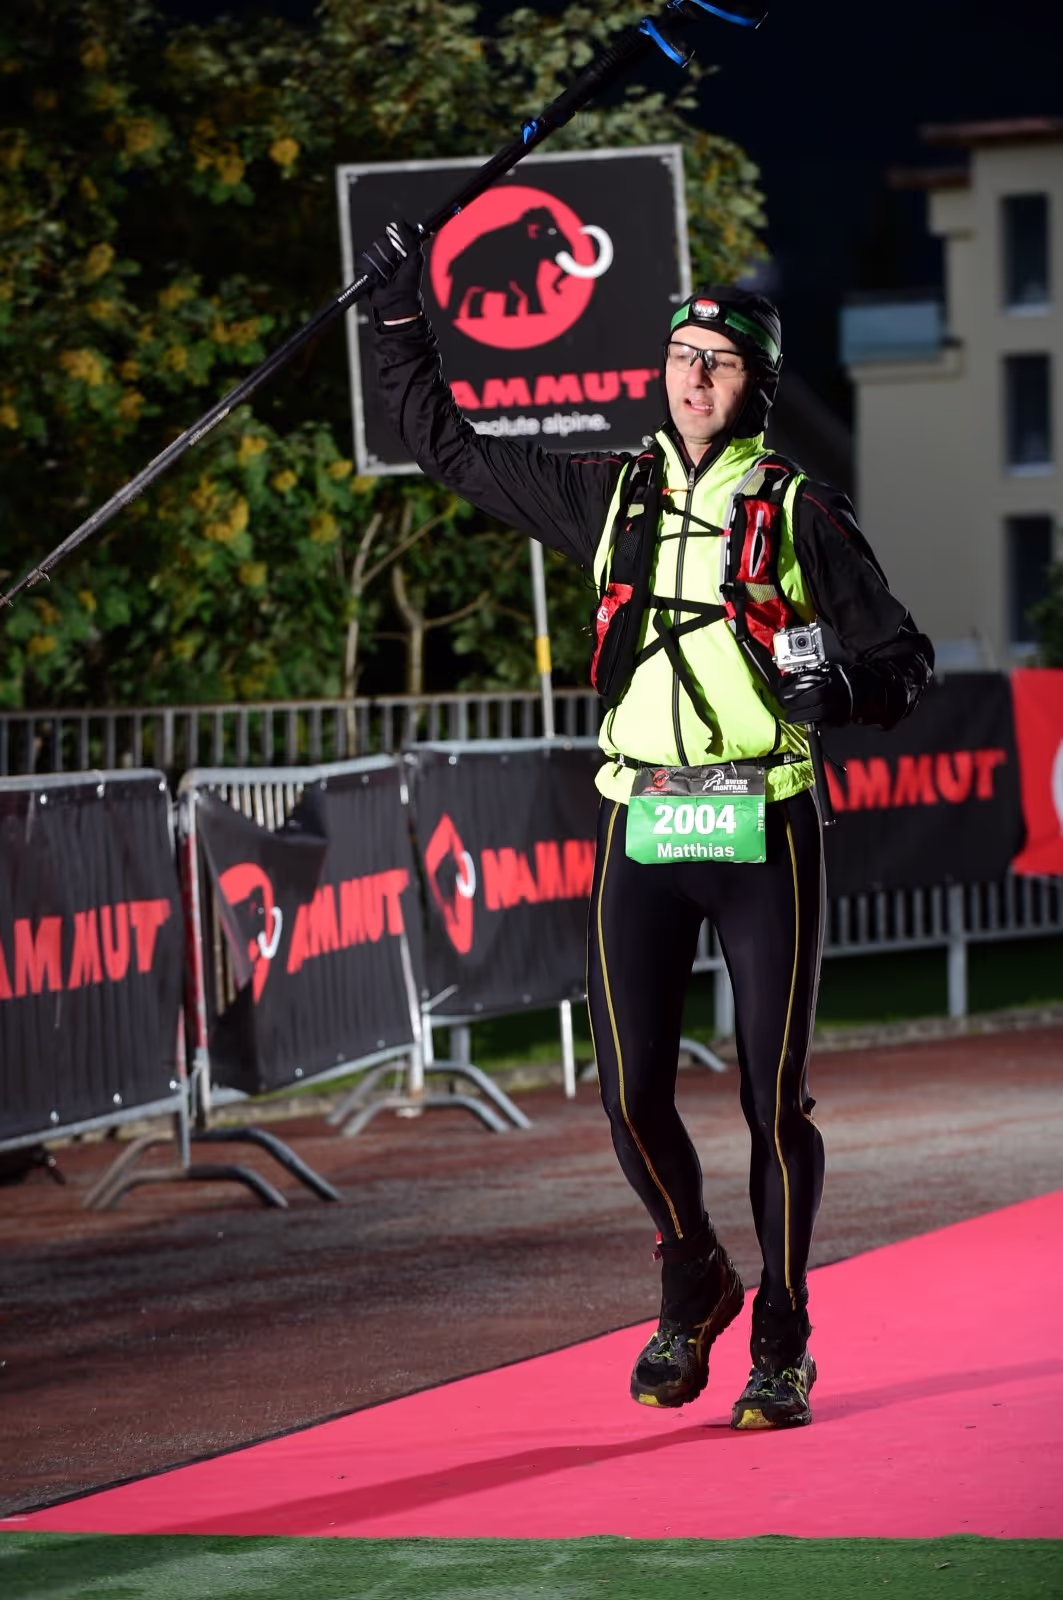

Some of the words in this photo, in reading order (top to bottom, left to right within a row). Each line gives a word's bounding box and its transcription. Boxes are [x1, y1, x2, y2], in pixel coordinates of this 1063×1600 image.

[450, 369, 653, 410] AMMUT
[468, 415, 540, 438] solute
[824, 747, 1007, 813] MMUT
[653, 804, 736, 835] 2004
[480, 838, 597, 912] MAMM
[657, 842, 735, 859] Matthias
[286, 867, 410, 976] AMMUT
[0, 898, 171, 999] MMUT
